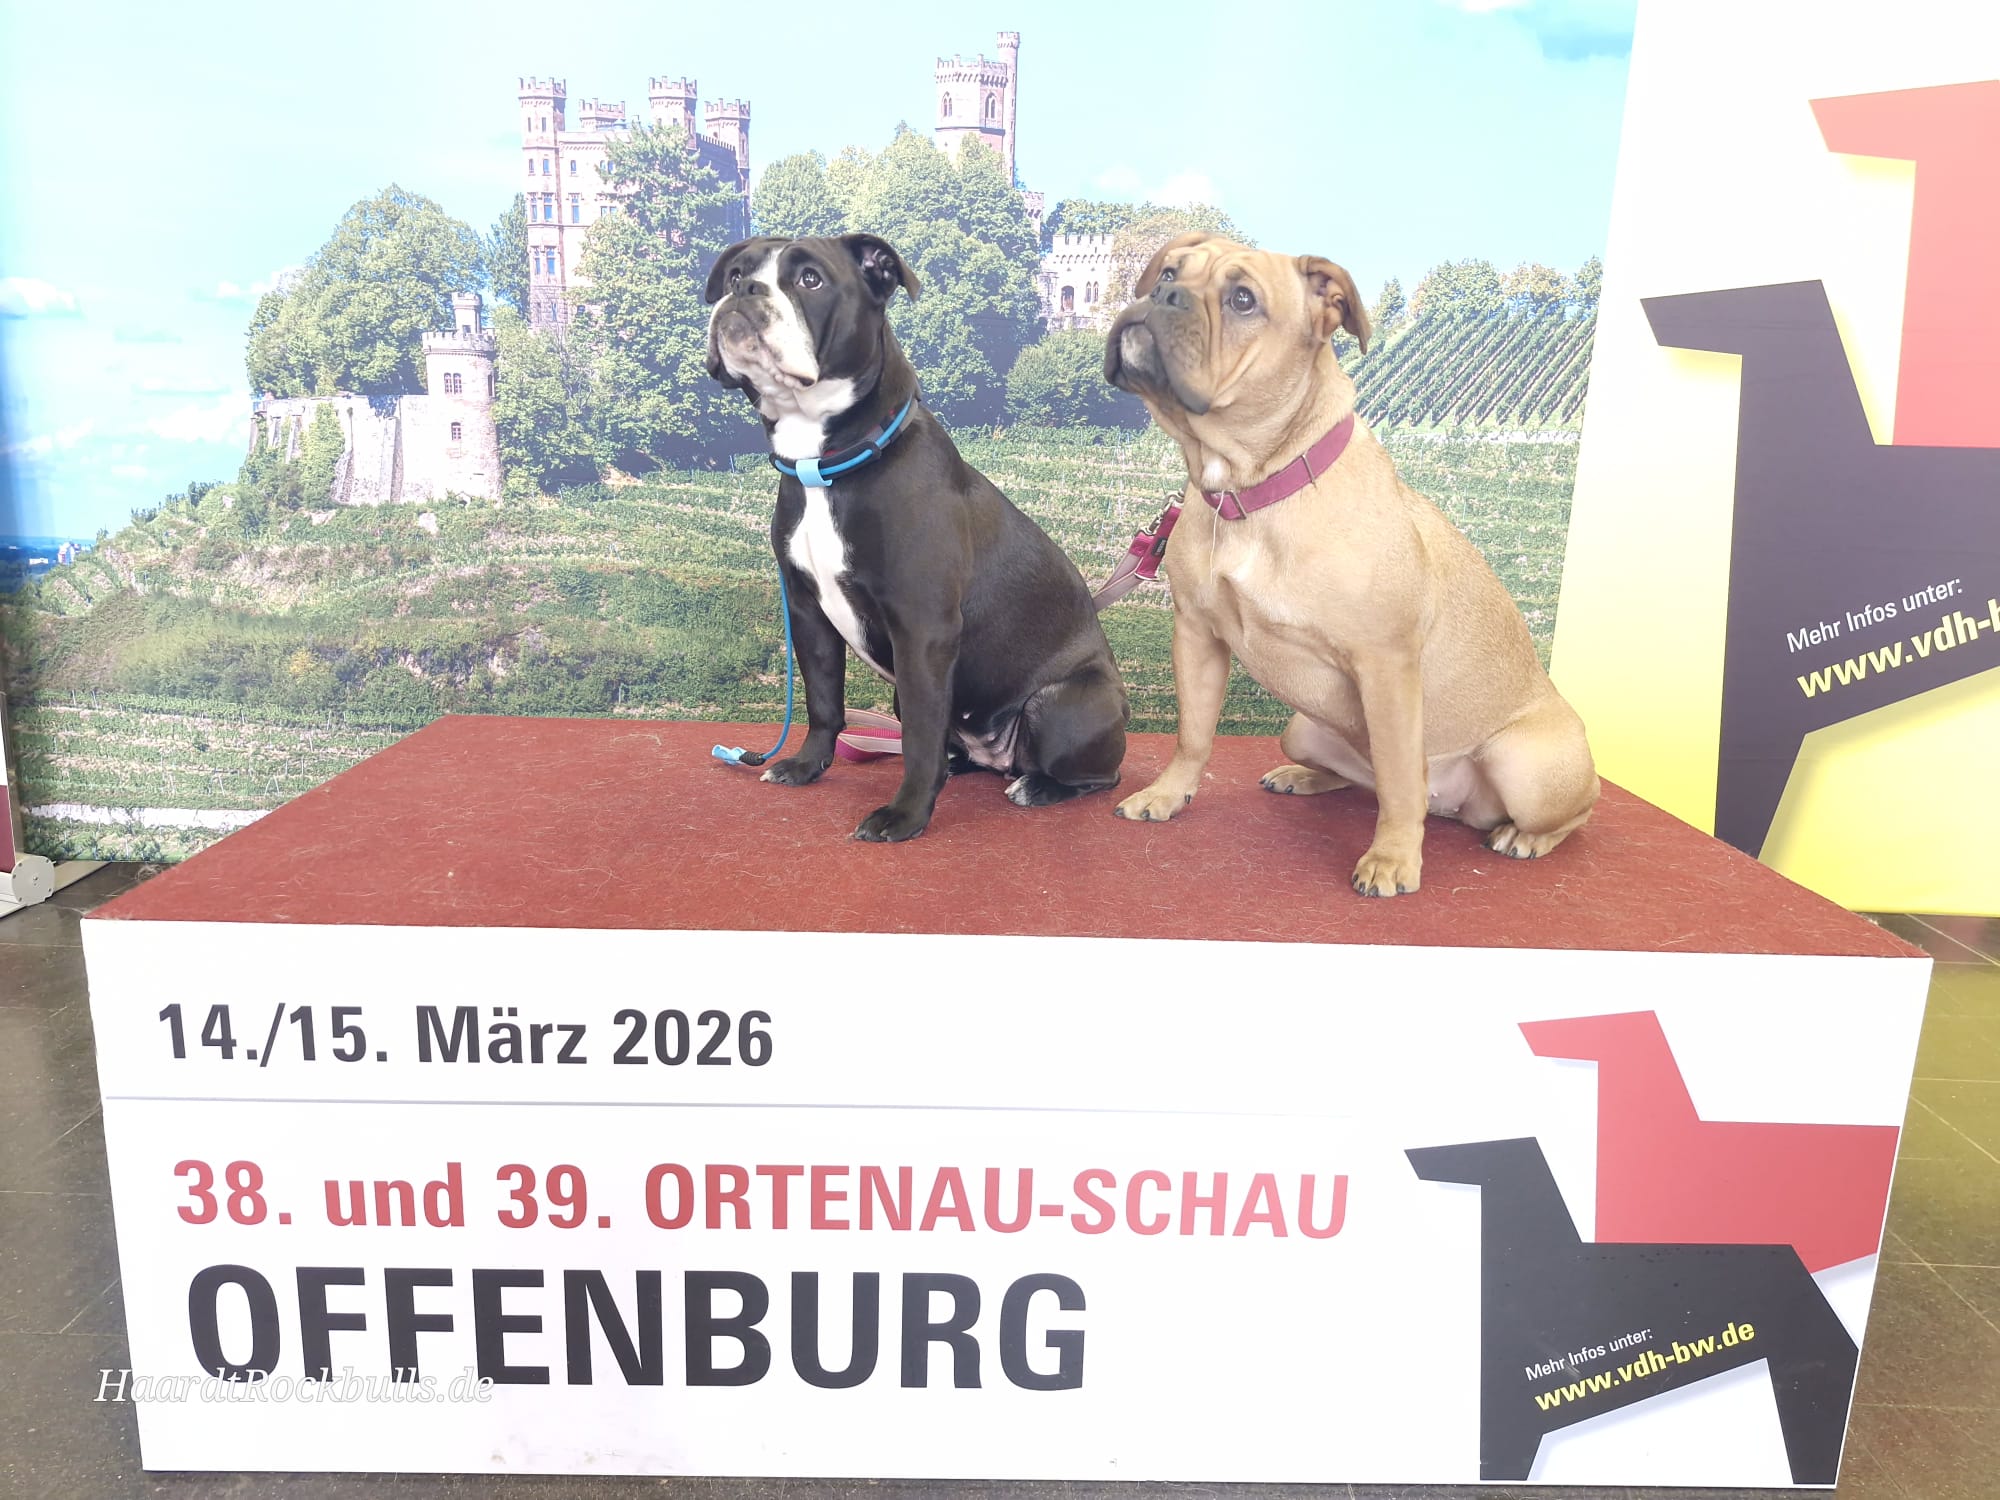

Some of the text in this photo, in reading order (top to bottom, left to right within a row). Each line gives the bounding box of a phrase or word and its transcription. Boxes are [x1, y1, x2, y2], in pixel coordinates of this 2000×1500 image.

[1786, 578, 1963, 653] Mehr Infos unter:
[159, 1002, 773, 1068] 14./15. März 2026
[173, 1159, 1349, 1240] 38. und 39. ORTENAU-SCHAU
[188, 1264, 1086, 1391] OFFENBURG
[1525, 1328, 1653, 1381] Mehr Infos unter:
[1534, 1321, 1756, 1411] www.vdh-bw.de
